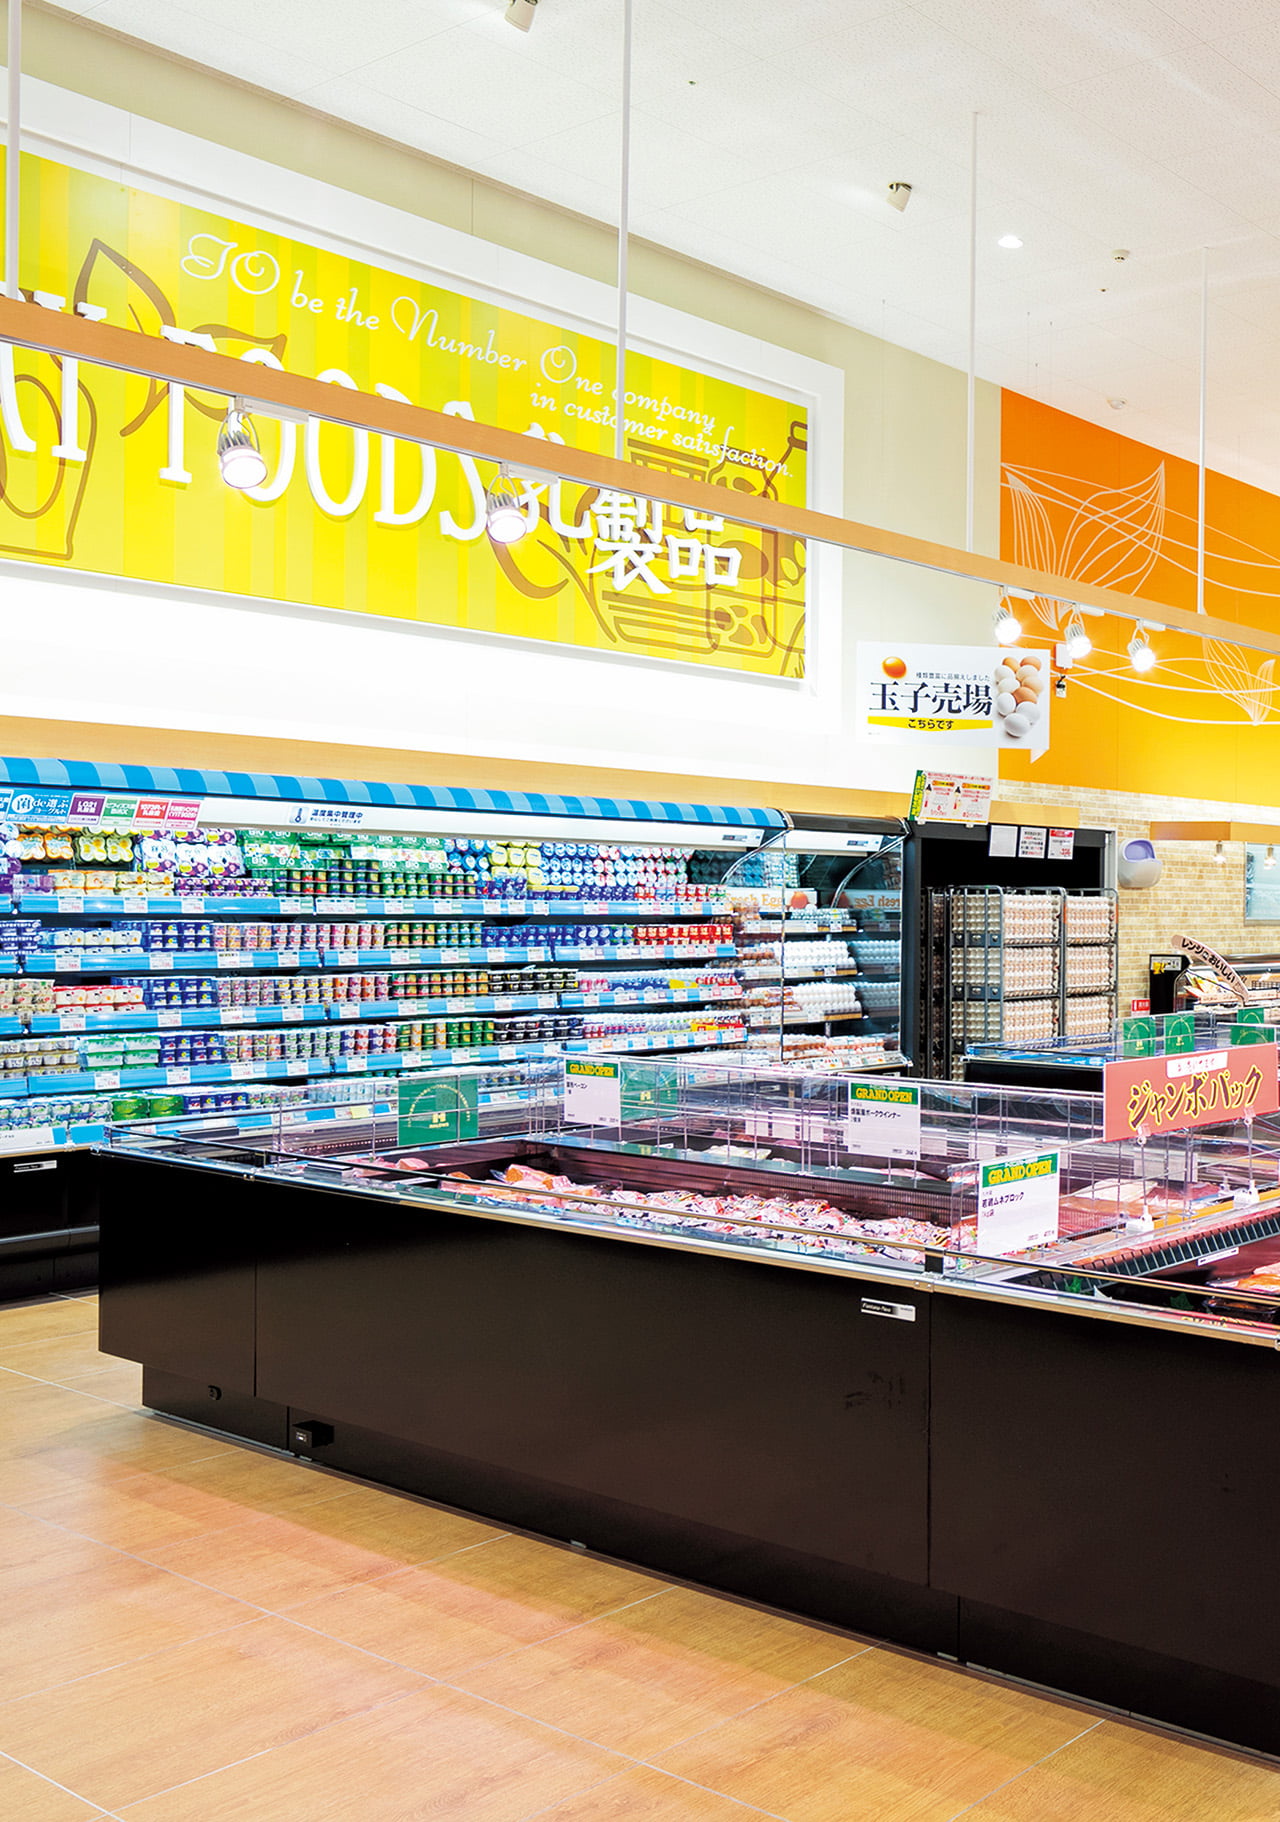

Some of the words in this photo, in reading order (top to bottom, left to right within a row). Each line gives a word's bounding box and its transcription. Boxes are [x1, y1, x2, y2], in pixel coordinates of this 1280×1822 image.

[291, 270, 324, 314] be
[336, 288, 380, 330] the
[391, 296, 527, 371] Number
[540, 345, 603, 395] One
[530, 383, 556, 411] in
[869, 681, 992, 716] 玉子売場
[908, 719, 954, 730] こちらです
[855, 1087, 887, 1101] GRAND
[888, 1090, 913, 1103] OPEN
[1128, 1065, 1263, 1131] ジャンボパック
[987, 1163, 1026, 1185] GRAND
[1025, 1158, 1053, 1178] OPEN
